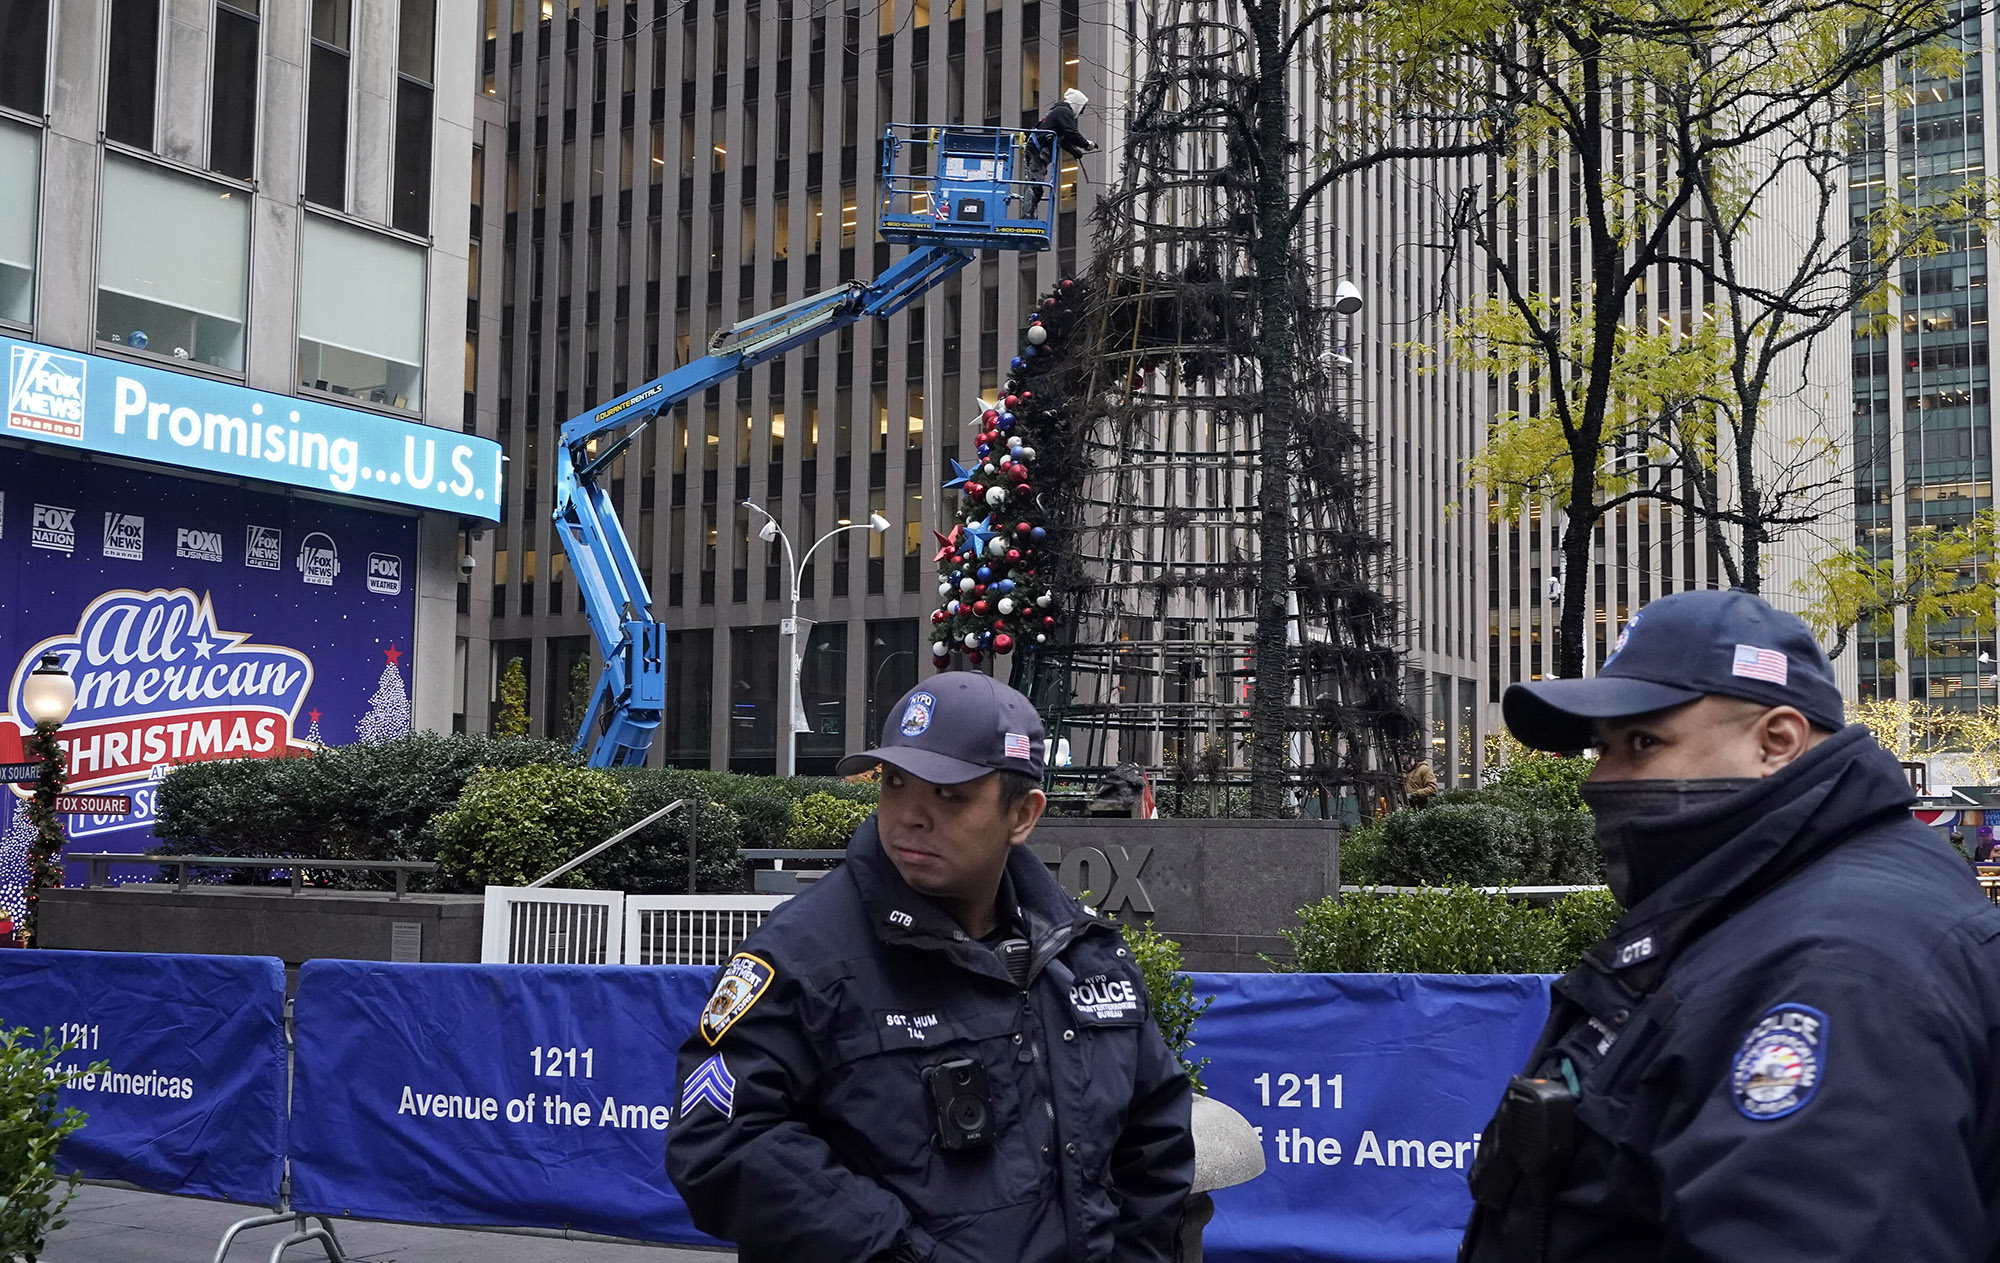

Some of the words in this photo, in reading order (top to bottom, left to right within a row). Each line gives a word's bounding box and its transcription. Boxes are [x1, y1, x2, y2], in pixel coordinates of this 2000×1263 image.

[34, 370, 81, 398] FOX
[20, 391, 81, 420] NEWS
[12, 416, 80, 436] channel
[33, 506, 76, 532] FOX
[32, 530, 75, 545] NATION
[116, 523, 142, 538] FOX
[109, 535, 142, 551] NEWS
[177, 528, 216, 552] FOX
[258, 536, 279, 550] FOX
[104, 549, 142, 559] channel
[176, 549, 223, 563] BUSINESS
[252, 547, 279, 560] NEWS
[313, 556, 332, 568] FOX
[249, 559, 277, 568] digital
[308, 566, 332, 578] NEWS
[370, 558, 399, 577] FOX
[306, 577, 331, 585] audio
[370, 579, 398, 591] WEATHER
[86, 604, 187, 665] All
[910, 693, 932, 706] NYPD
[151, 765, 168, 779] AT
[55, 797, 78, 811] FOX
[80, 799, 127, 813] SQUARE
[889, 910, 913, 927] CTB
[1622, 937, 1652, 963] CTB
[1069, 980, 1137, 1005] POLICE
[731, 992, 754, 1016] YORK
[913, 1014, 938, 1028] HUM
[59, 1022, 100, 1050] 1211
[530, 1046, 594, 1078] 1211
[100, 1068, 194, 1100] Americas
[1254, 1072, 1343, 1109] 1211
[398, 1085, 498, 1121] Avenue
[506, 1092, 536, 1124] of
[543, 1094, 591, 1127] the
[599, 1096, 673, 1131] Ame
[1275, 1128, 1342, 1166] the
